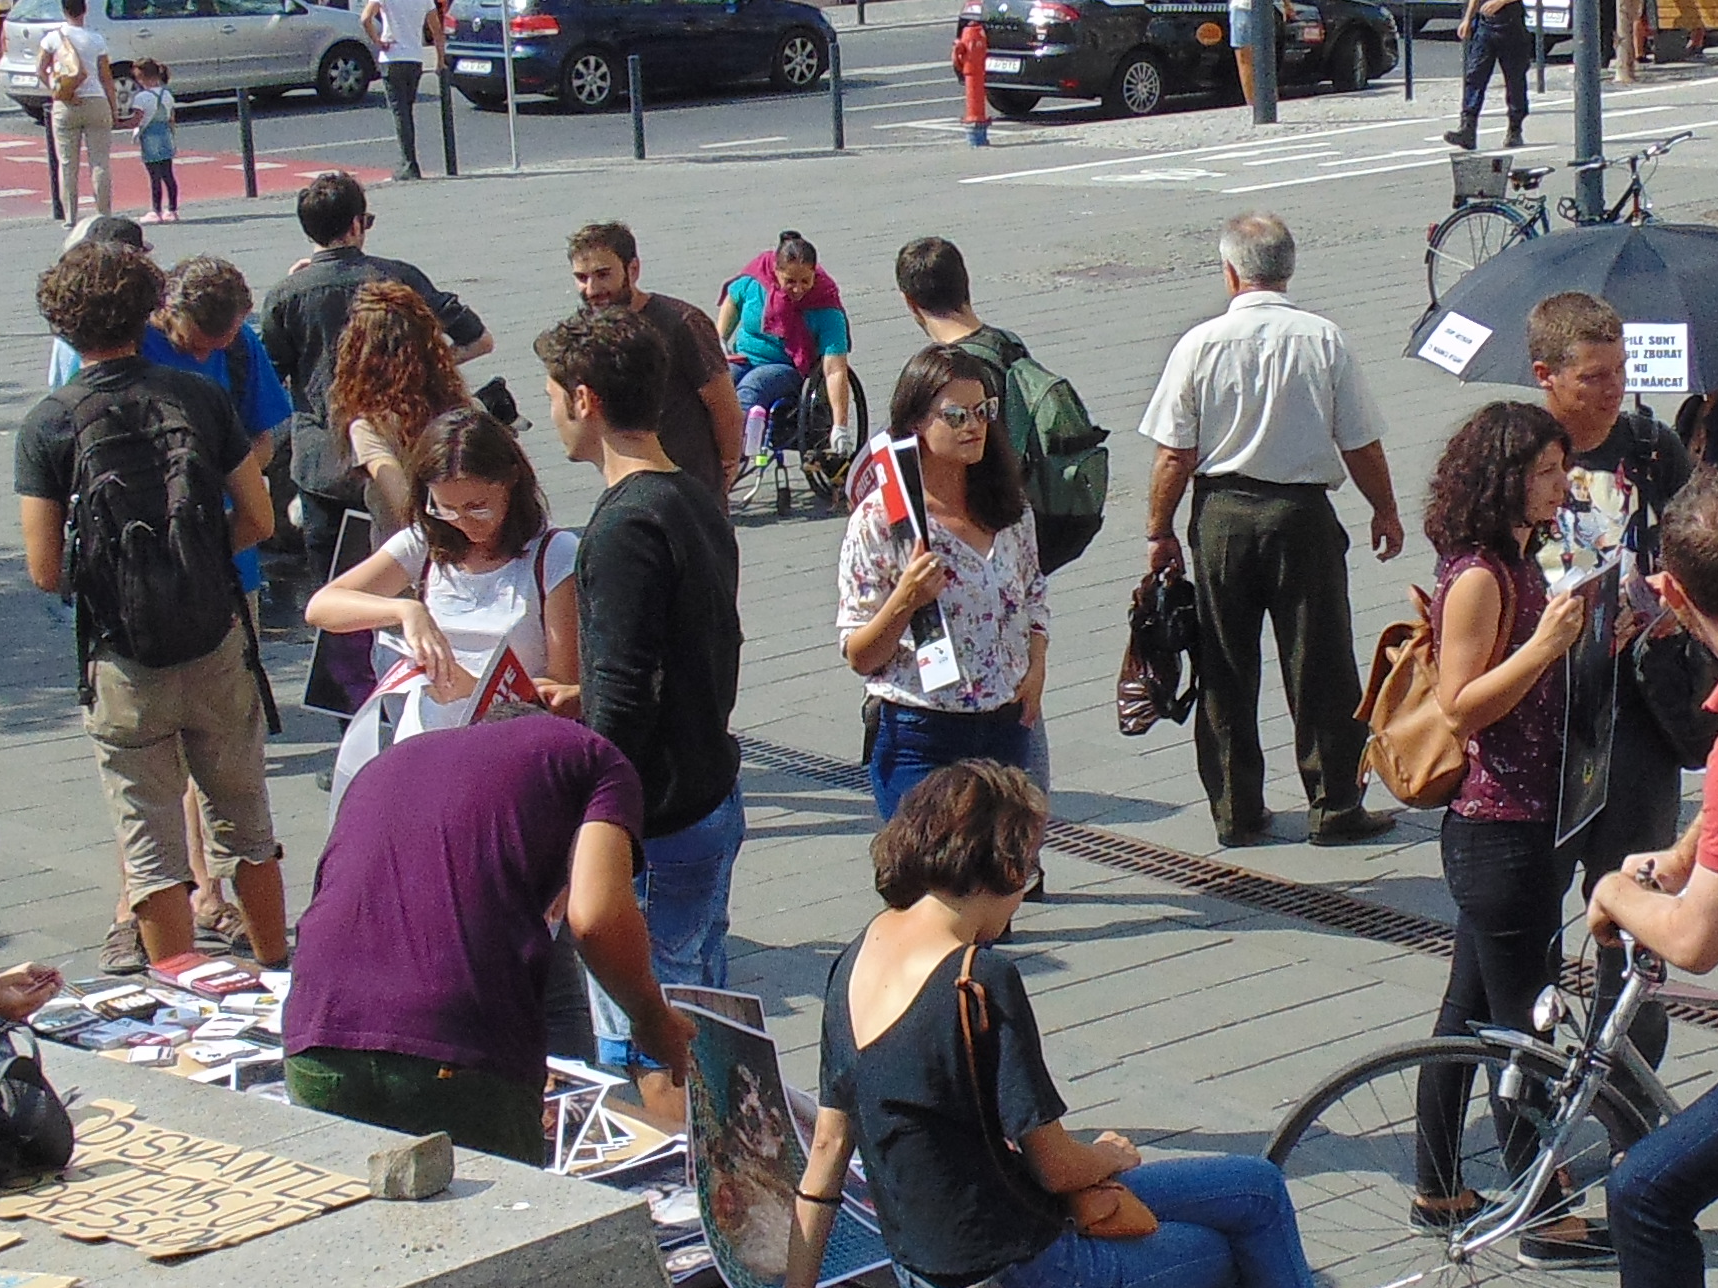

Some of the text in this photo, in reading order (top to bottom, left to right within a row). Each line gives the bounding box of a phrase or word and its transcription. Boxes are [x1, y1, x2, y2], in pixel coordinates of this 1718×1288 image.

[1648, 335, 1676, 345] SUNT
[1643, 349, 1683, 359] ZBURAT
[1633, 363, 1648, 373] NU
[1640, 376, 1684, 388] MÂNCAT
